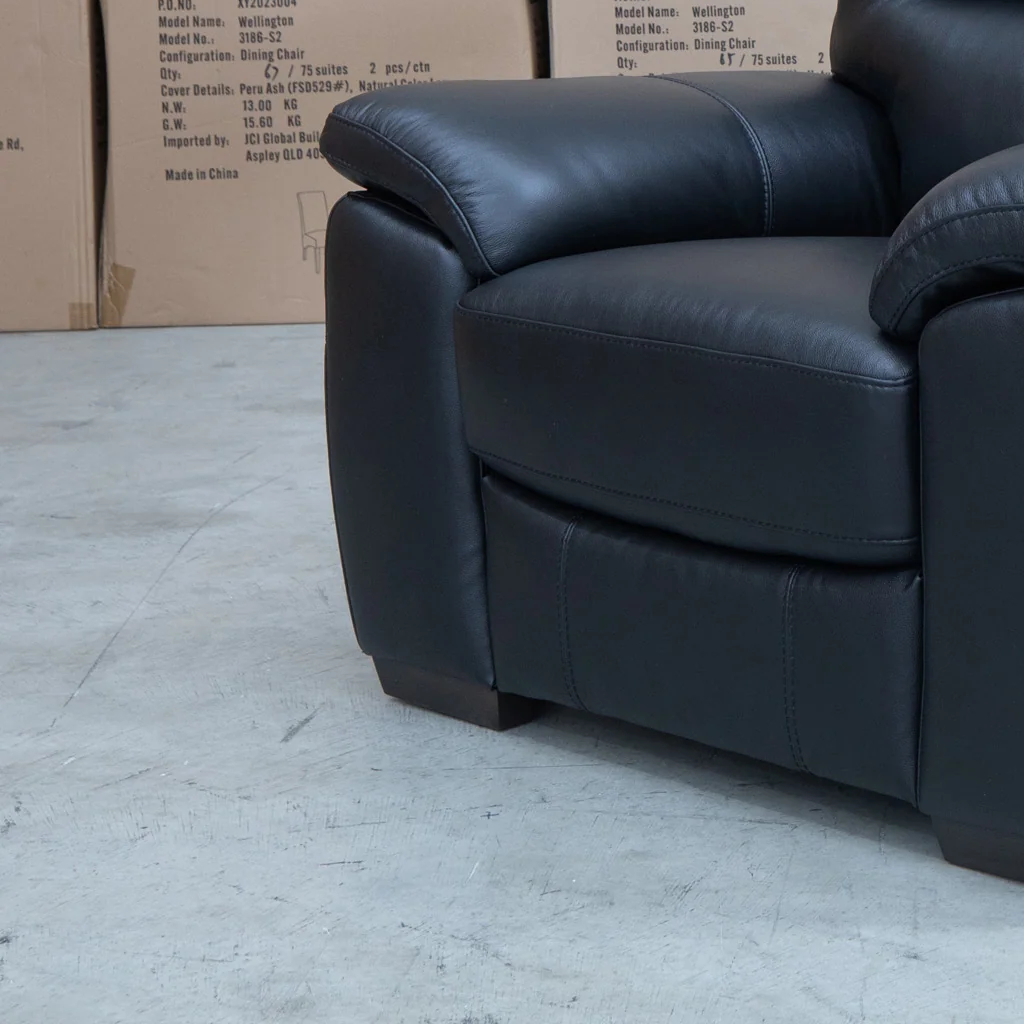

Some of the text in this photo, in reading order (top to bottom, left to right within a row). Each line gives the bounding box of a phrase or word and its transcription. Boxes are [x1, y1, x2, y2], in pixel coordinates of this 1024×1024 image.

[692, 5, 745, 18] Wellington
[238, 16, 293, 29] Wellington
[693, 20, 734, 33] 3186-S2
[694, 37, 756, 52] Dining Chair
[241, 49, 274, 62] Dining
[277, 48, 304, 60] Chair
[752, 54, 797, 65] 75 suites
[161, 84, 190, 96] Cover
[240, 83, 263, 94] Peru
[266, 82, 284, 94] Ash
